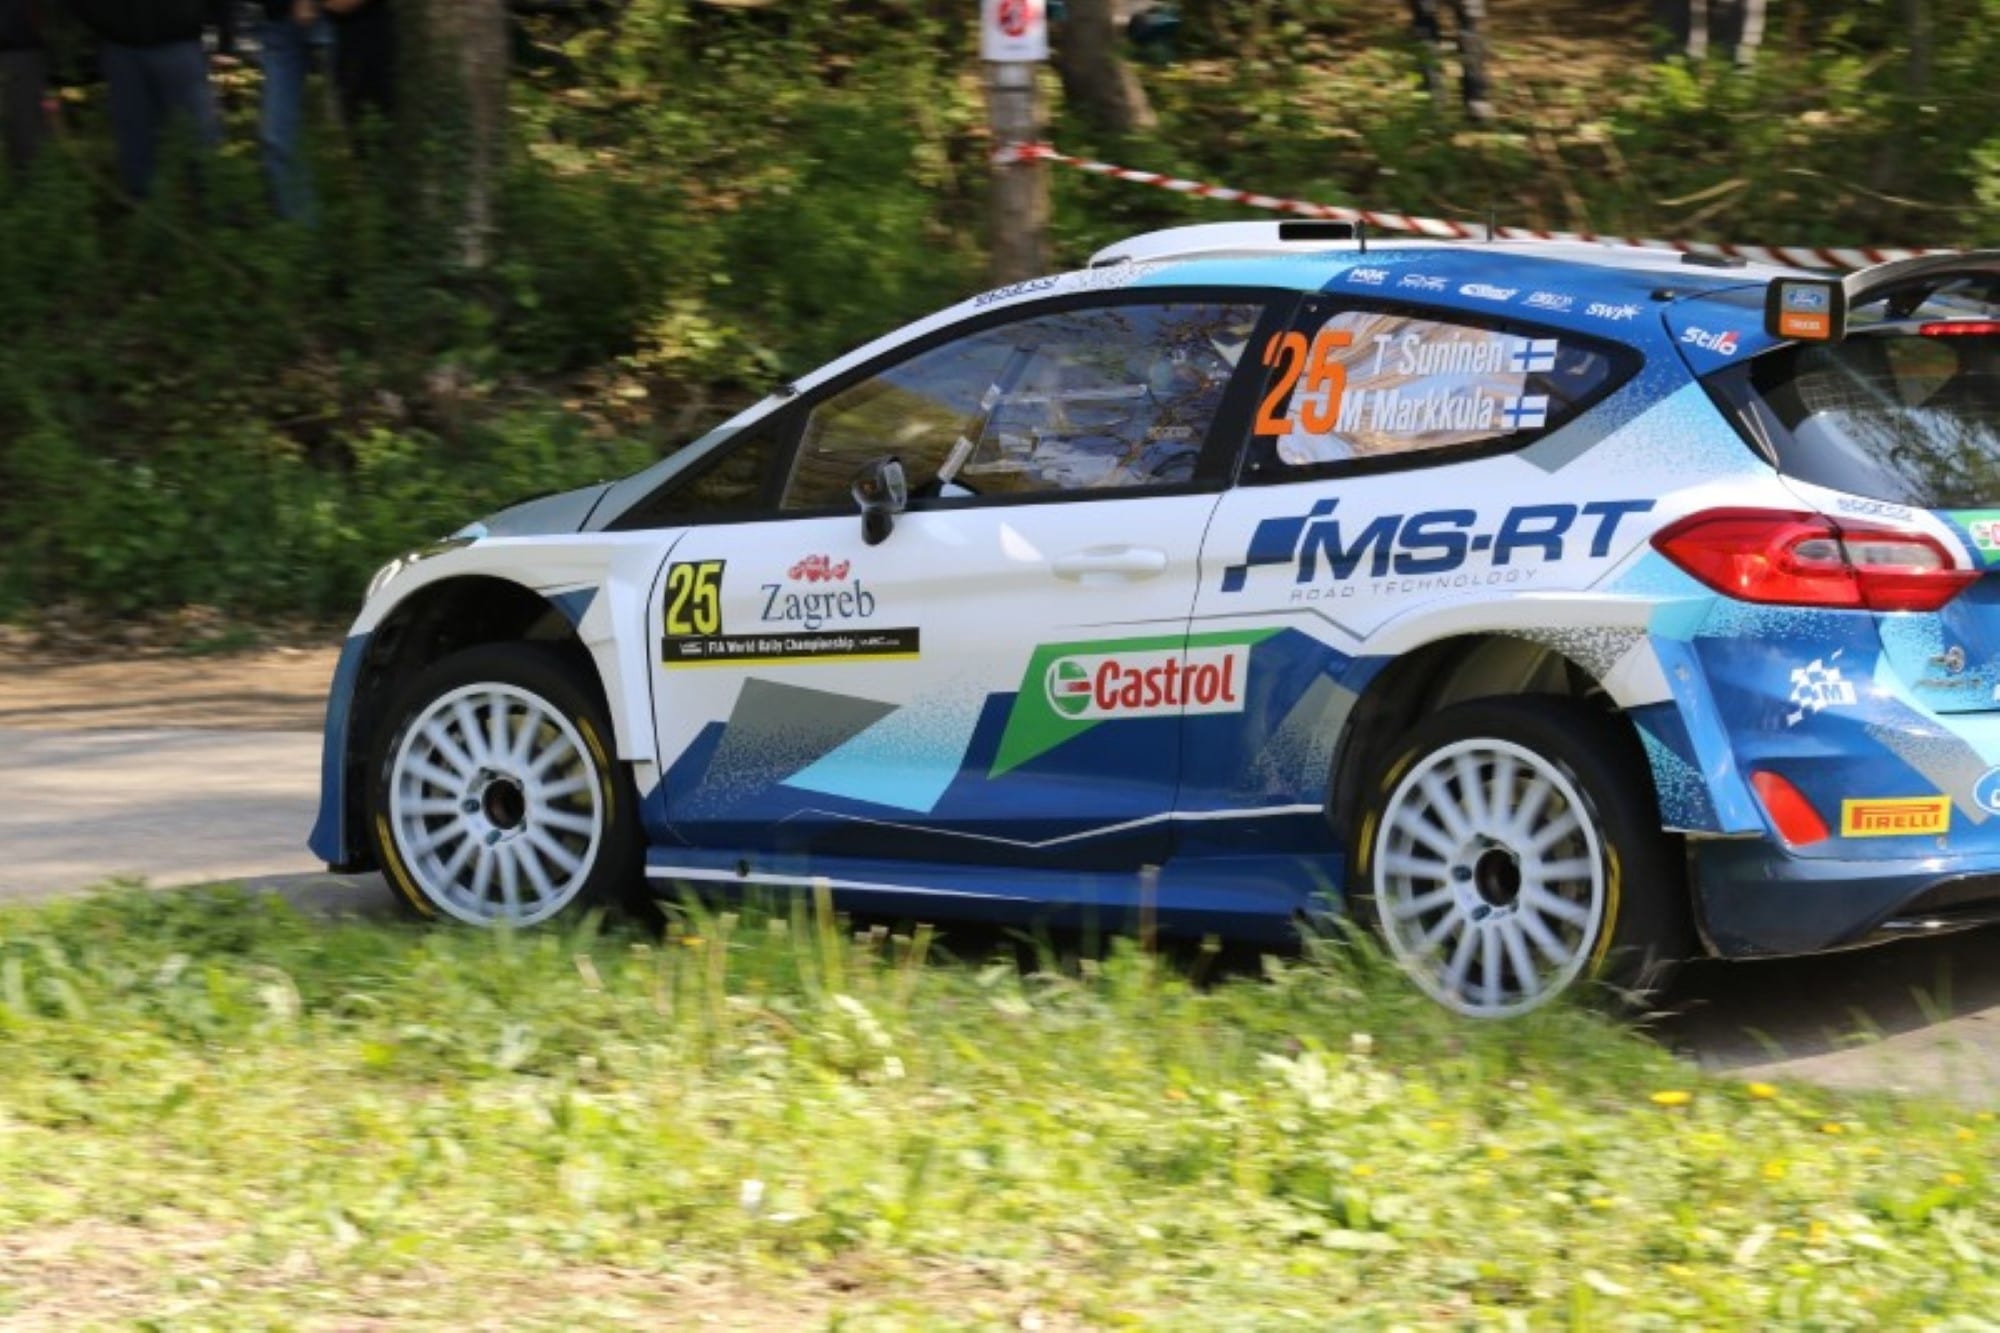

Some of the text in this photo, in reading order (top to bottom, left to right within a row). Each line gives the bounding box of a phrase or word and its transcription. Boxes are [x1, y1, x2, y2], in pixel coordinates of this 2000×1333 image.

[1372, 333, 1504, 376] T Suninen
[1680, 326, 1739, 355] Stilo
[1254, 331, 1354, 436] 25
[1334, 386, 1496, 433] M Markkula
[1297, 498, 1657, 583] MS-RT
[666, 562, 722, 634] 25
[761, 579, 875, 630] Zagreb
[1290, 568, 1538, 602] ROAD TECHNOLOGY
[708, 641, 725, 654] FIA
[726, 640, 755, 653] World
[759, 639, 783, 655] Rally
[785, 636, 854, 653] Championship
[1095, 653, 1235, 710] Castrol
[1852, 804, 1942, 830] PIRELLI
